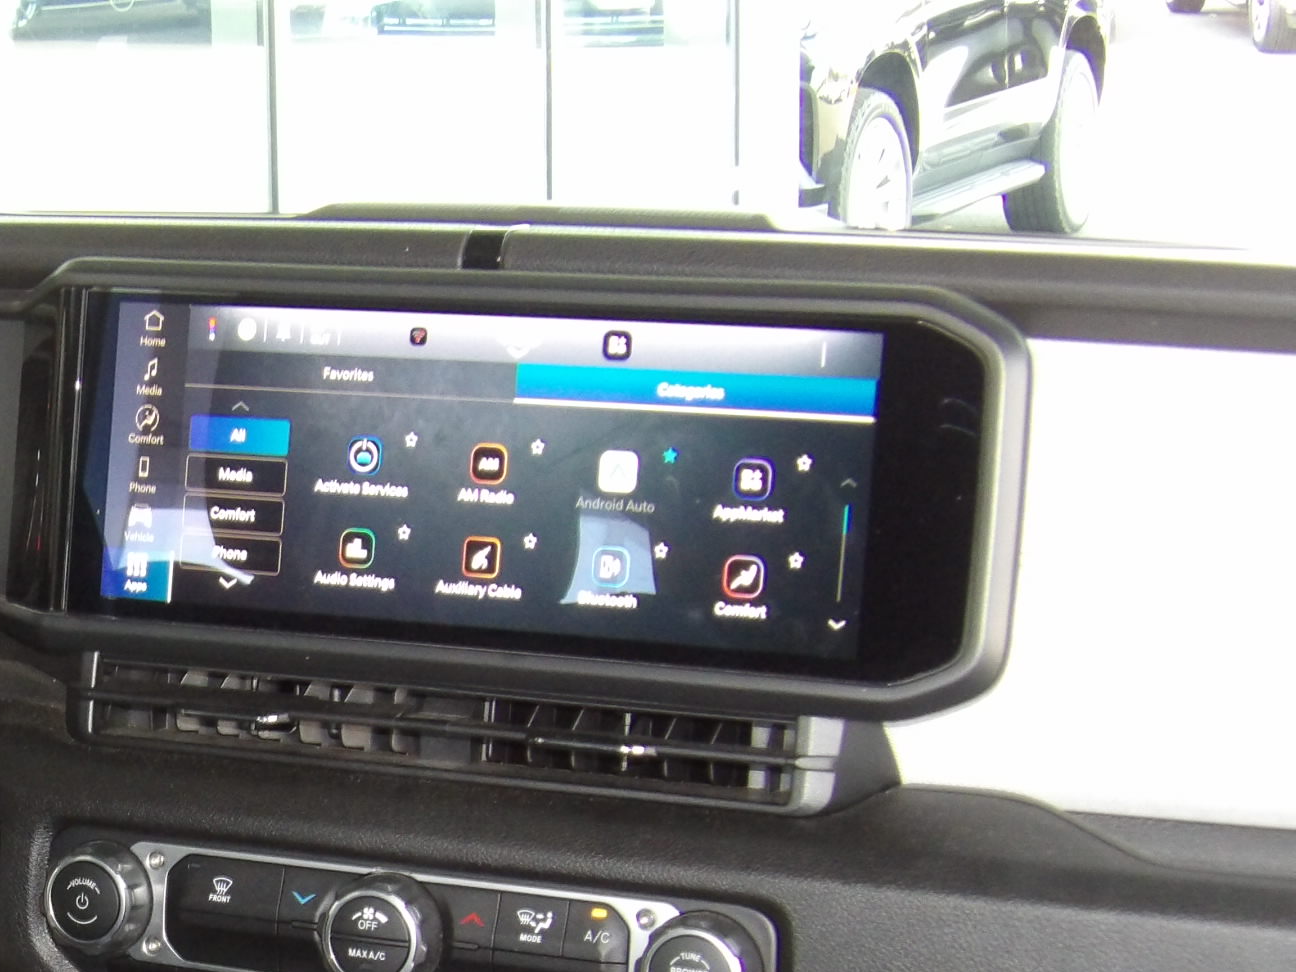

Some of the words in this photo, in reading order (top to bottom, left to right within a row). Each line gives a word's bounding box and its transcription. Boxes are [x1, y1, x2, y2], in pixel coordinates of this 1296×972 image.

[140, 336, 166, 347] Home
[323, 366, 374, 382] Favorites
[136, 384, 163, 397] Media
[656, 381, 726, 401] Categories
[128, 433, 164, 446] Comfort
[230, 428, 247, 443] All
[218, 467, 253, 482] Media
[129, 482, 156, 494] Phone
[314, 478, 360, 495] Activate
[362, 481, 409, 498] Services
[457, 488, 478, 502] AM
[480, 489, 515, 505] Radio
[575, 495, 623, 511] Android
[626, 499, 655, 514] Auto
[210, 506, 256, 522] Comfort
[124, 530, 154, 543] Vehicle
[212, 545, 248, 561] Phone
[124, 577, 147, 593] Apps
[314, 570, 348, 586] Audio
[349, 572, 395, 592] Settings
[435, 579, 487, 600] Auxiliary
[488, 583, 522, 601] Cable
[714, 601, 767, 620] Comfort
[71, 877, 97, 889] VOLUME
[208, 894, 231, 903] FRONT
[357, 920, 379, 931] OFF
[519, 933, 542, 943] MODE
[584, 930, 610, 944] A/C
[348, 948, 368, 958] MAX
[368, 951, 386, 961] A/C
[679, 952, 702, 963] TUNE
